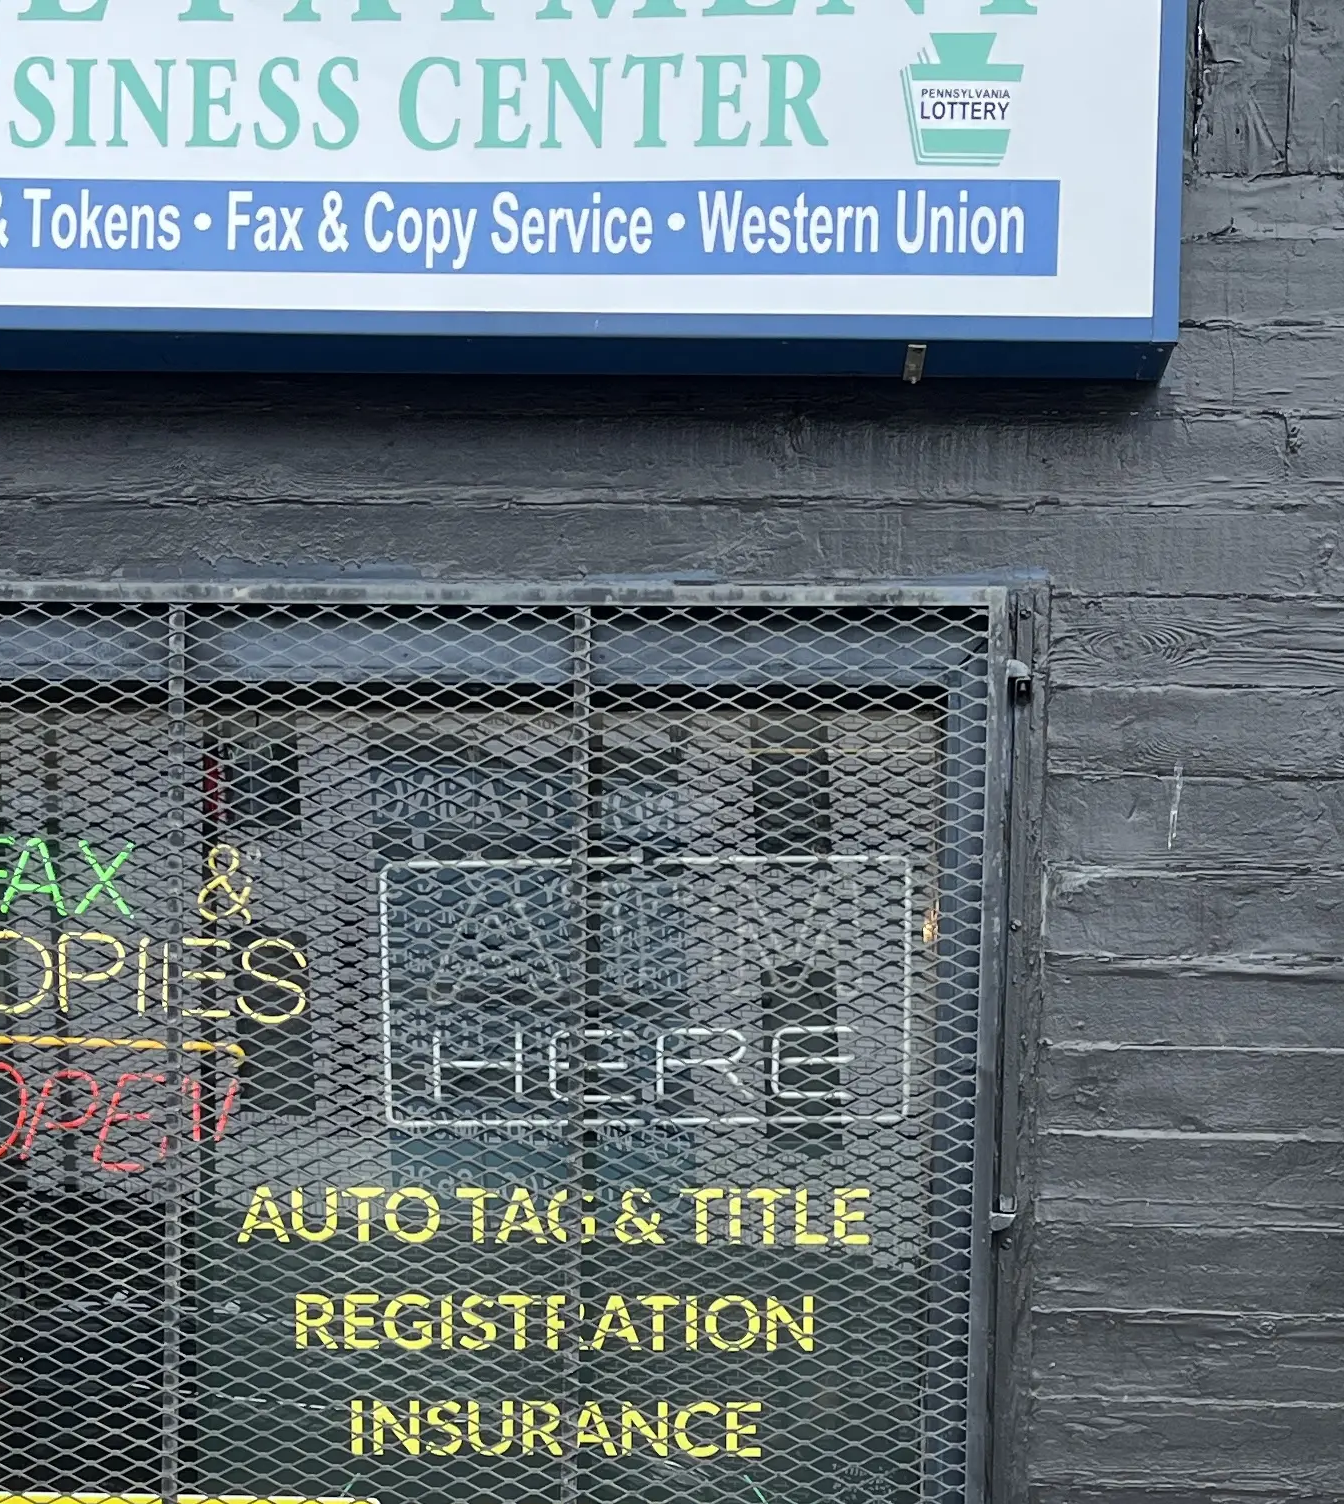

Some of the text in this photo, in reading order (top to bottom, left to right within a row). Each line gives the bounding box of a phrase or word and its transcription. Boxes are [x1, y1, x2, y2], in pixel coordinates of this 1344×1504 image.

[398, 53, 829, 151] CENTER
[920, 87, 1011, 101] PENNSYLVANIA
[920, 99, 1011, 122] LOTTERY
[23, 187, 182, 251] Tokens
[227, 191, 300, 251] Fax
[318, 191, 350, 253] &
[363, 191, 478, 269] Copy
[490, 190, 654, 255] Service
[697, 189, 879, 255] Western
[895, 189, 1024, 255] Union
[197, 843, 253, 924] &
[433, 1026, 856, 1105] HERE
[237, 1187, 870, 1245] AUTO TAG & TITLE
[295, 1293, 815, 1352] REGISTRATION
[350, 1400, 762, 1458] INSURANCE
